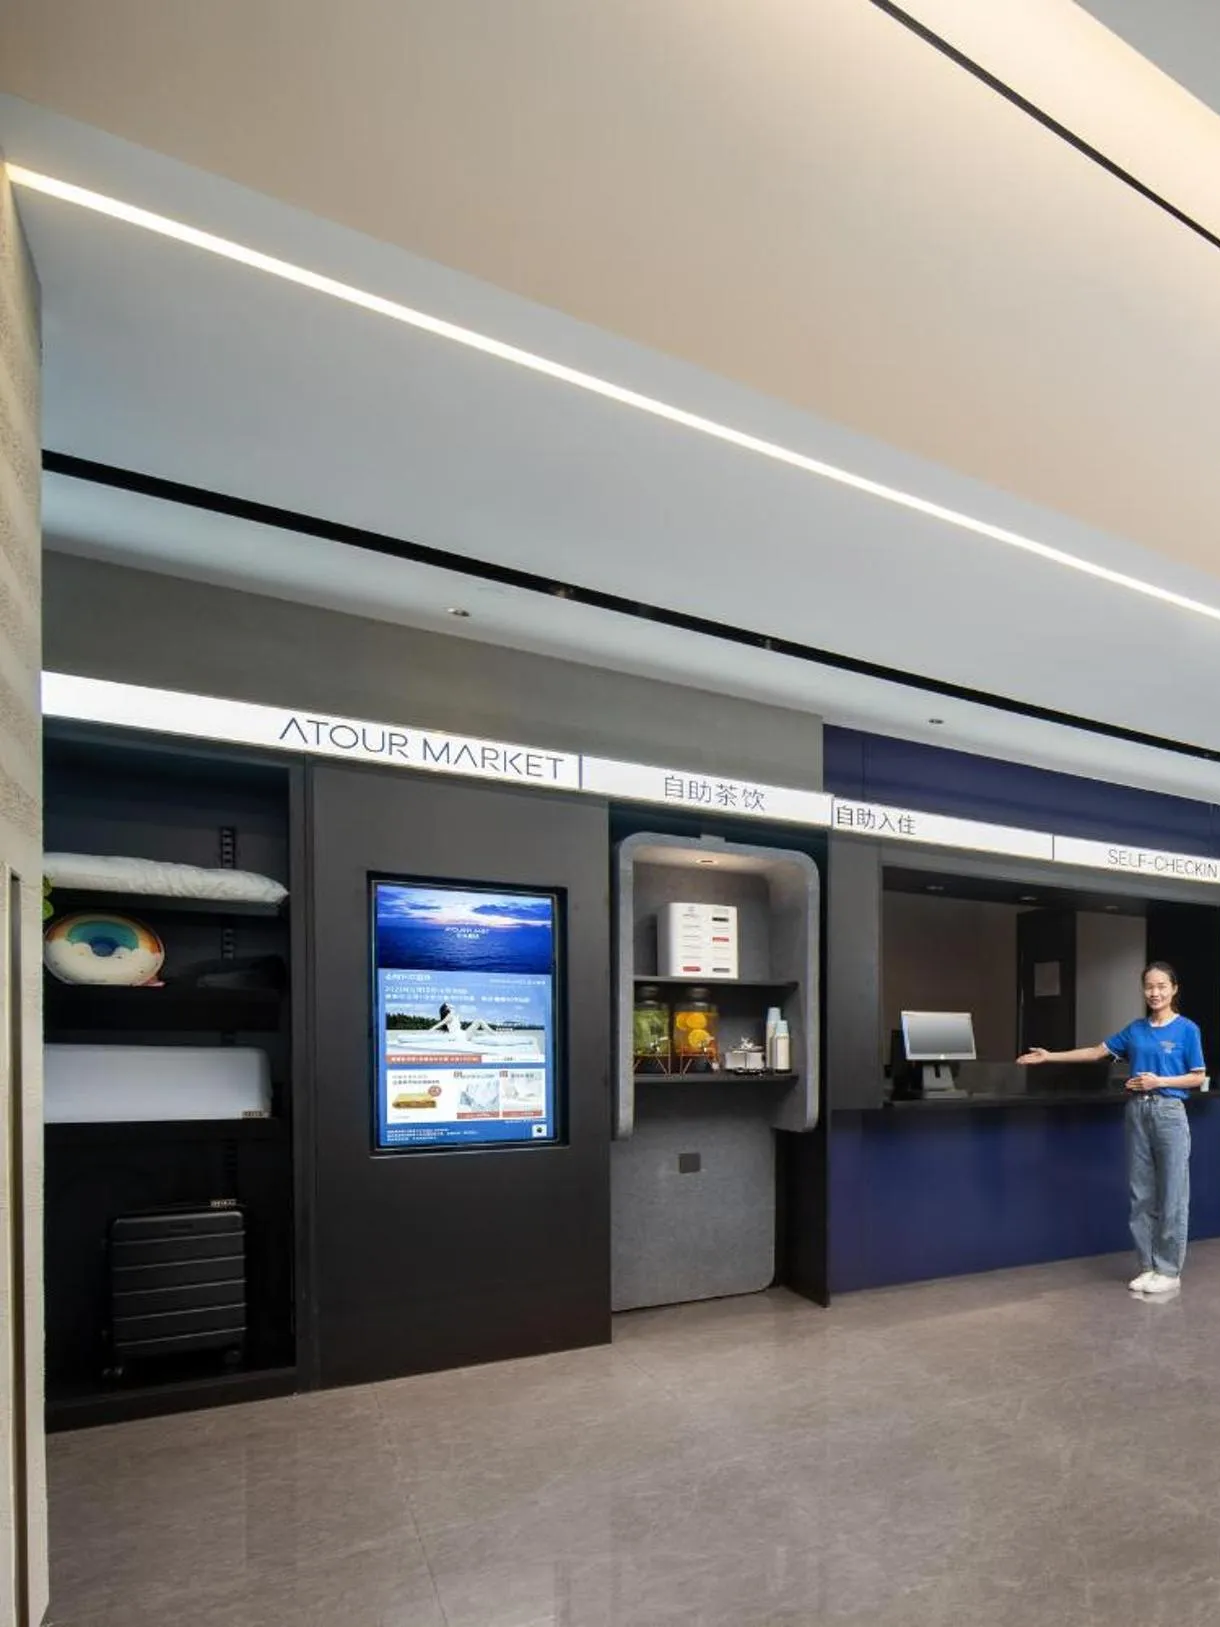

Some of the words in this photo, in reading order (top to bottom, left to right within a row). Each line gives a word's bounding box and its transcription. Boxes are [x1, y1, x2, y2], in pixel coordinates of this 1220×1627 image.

[279, 716, 409, 759] ATOUR
[421, 737, 565, 780] MARKET
[664, 775, 766, 812] 自助茶饮
[836, 804, 917, 836] 自助入住
[1108, 848, 1218, 880] SELF-CHECKIN
